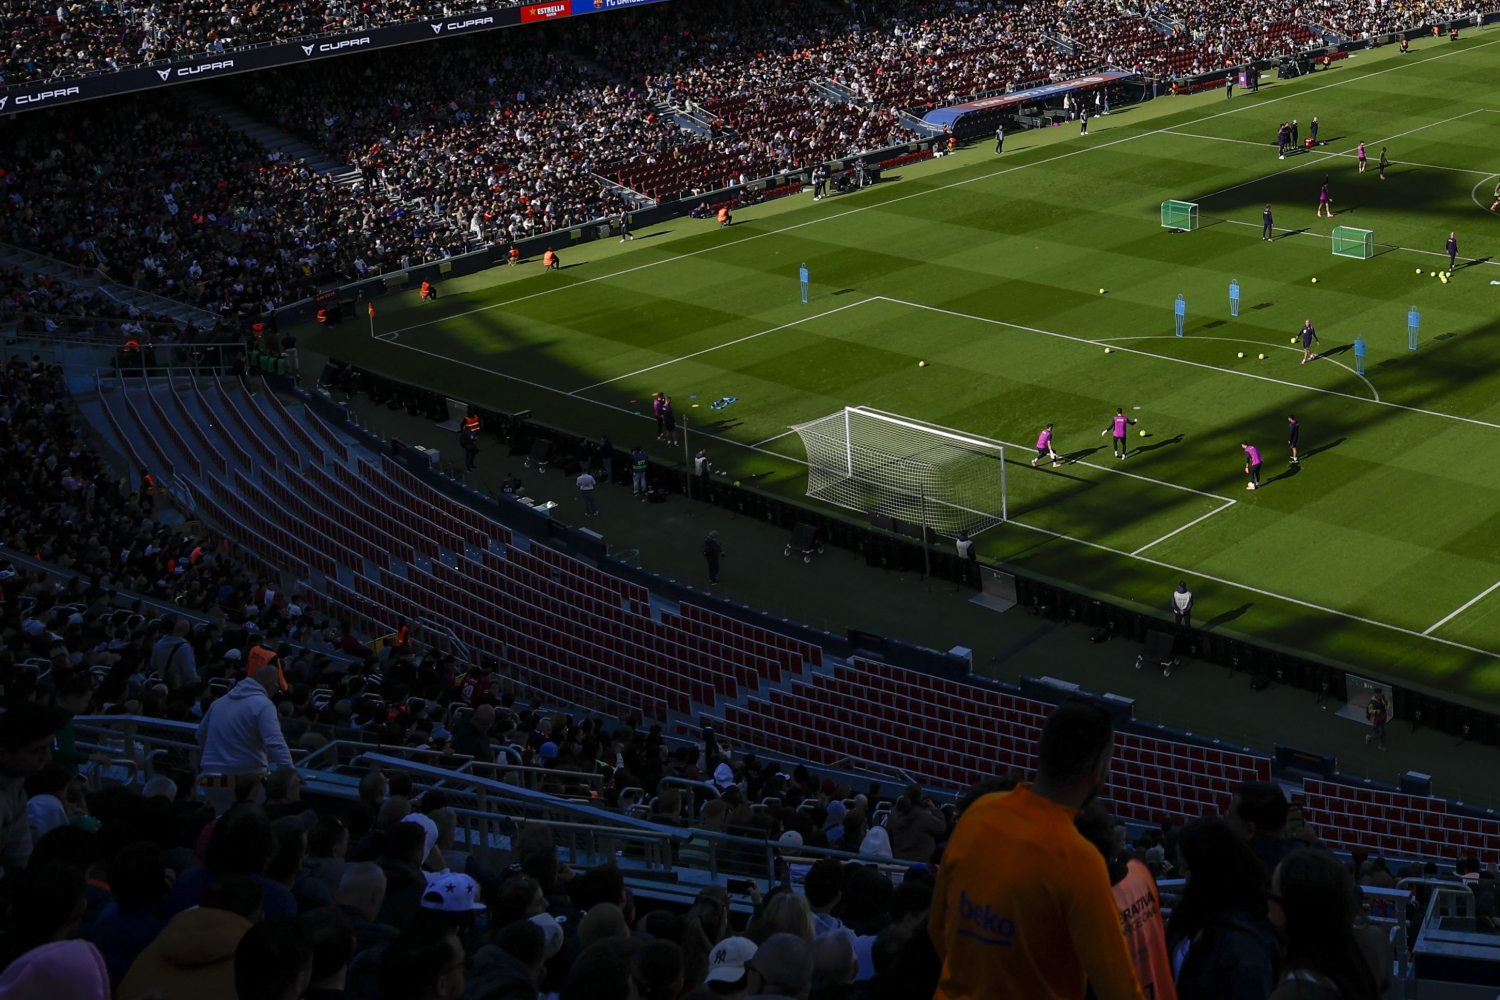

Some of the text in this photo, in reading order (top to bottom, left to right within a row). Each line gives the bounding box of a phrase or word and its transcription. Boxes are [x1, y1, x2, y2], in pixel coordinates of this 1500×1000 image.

[537, 5, 565, 15] ESTRELLA
[447, 17, 493, 30] CUPRA
[319, 37, 370, 52] CUPRA
[178, 59, 234, 76] CUPRA
[15, 86, 79, 105] CUPRA
[462, 682, 475, 698] 20
[959, 890, 1015, 938] beko
